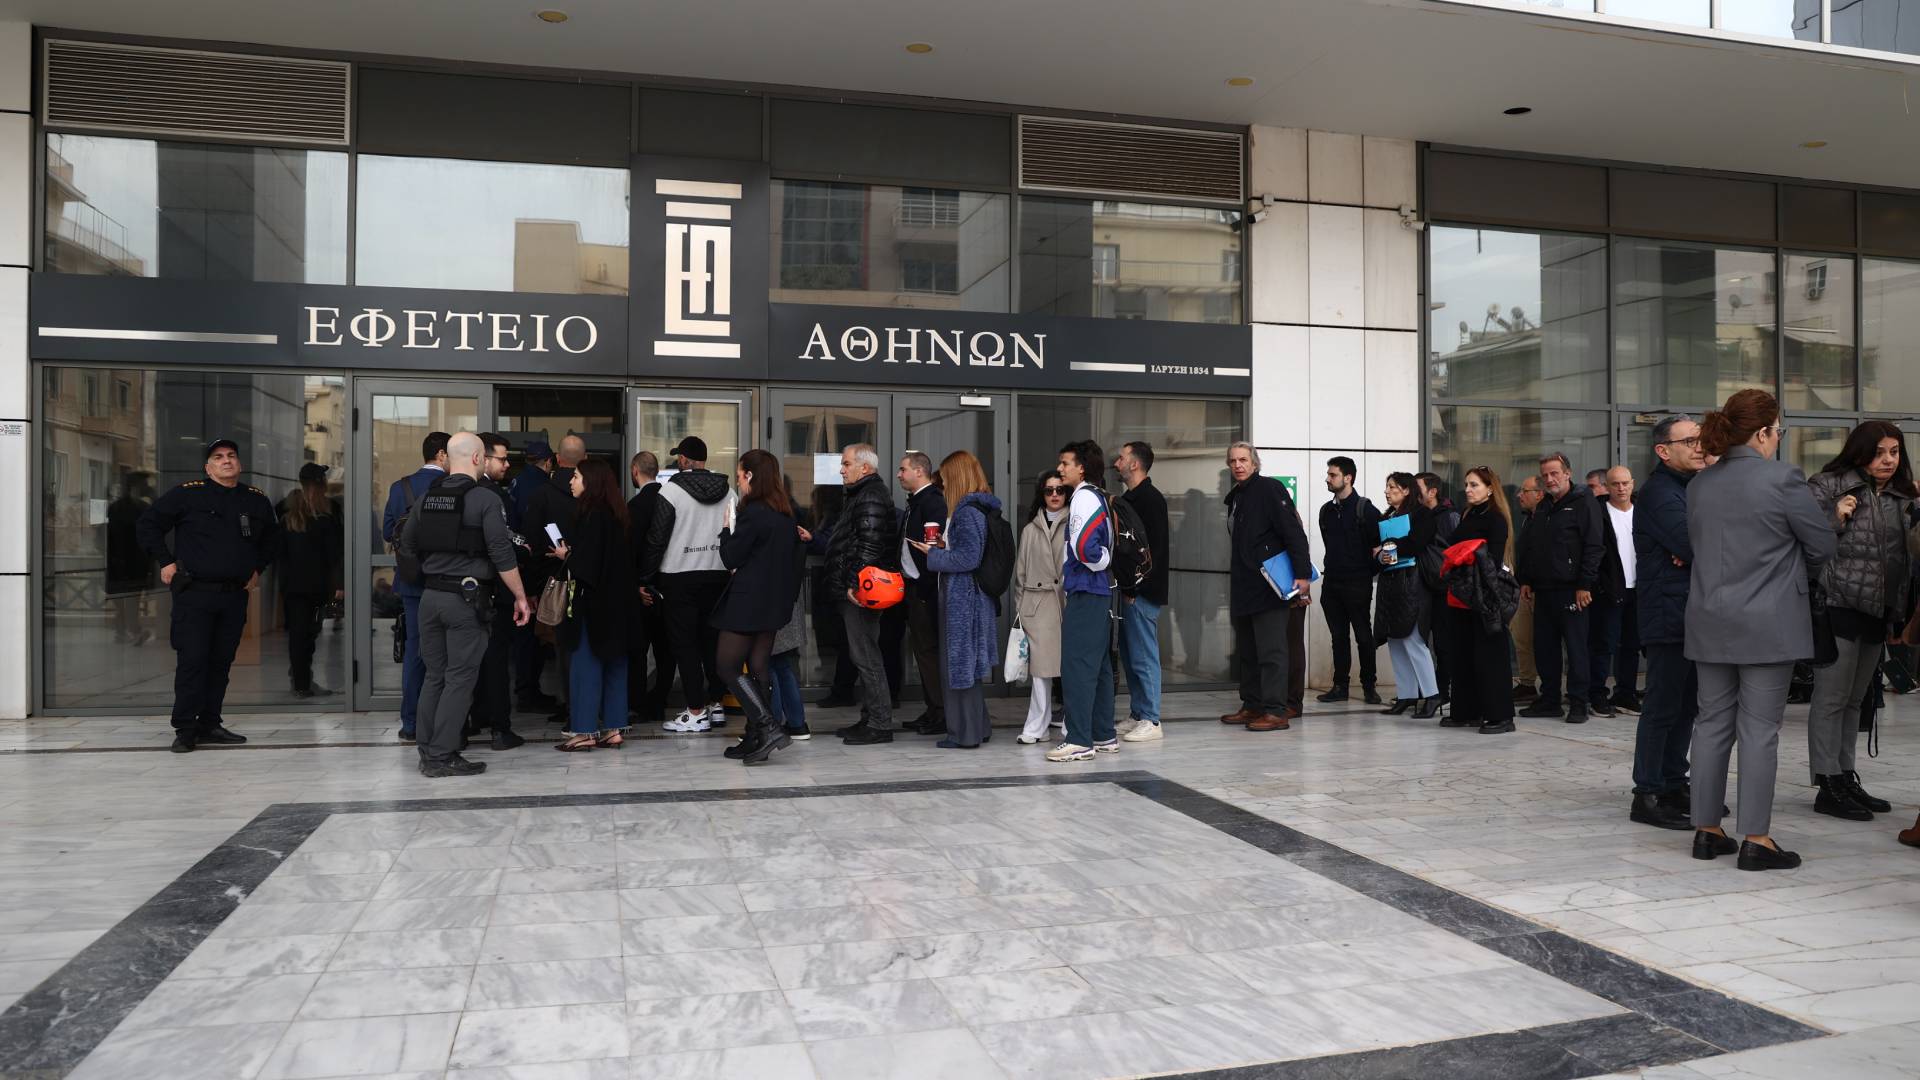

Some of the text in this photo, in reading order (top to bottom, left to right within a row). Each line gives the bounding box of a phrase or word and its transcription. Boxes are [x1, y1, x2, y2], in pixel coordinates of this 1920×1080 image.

[304, 306, 598, 354] ΕΦΕΤΕΙΟ
[799, 322, 1047, 369] ΑΘΗΝΩΝ
[1151, 364, 1210, 375] ΙΔΡΥΣΗ 1834
